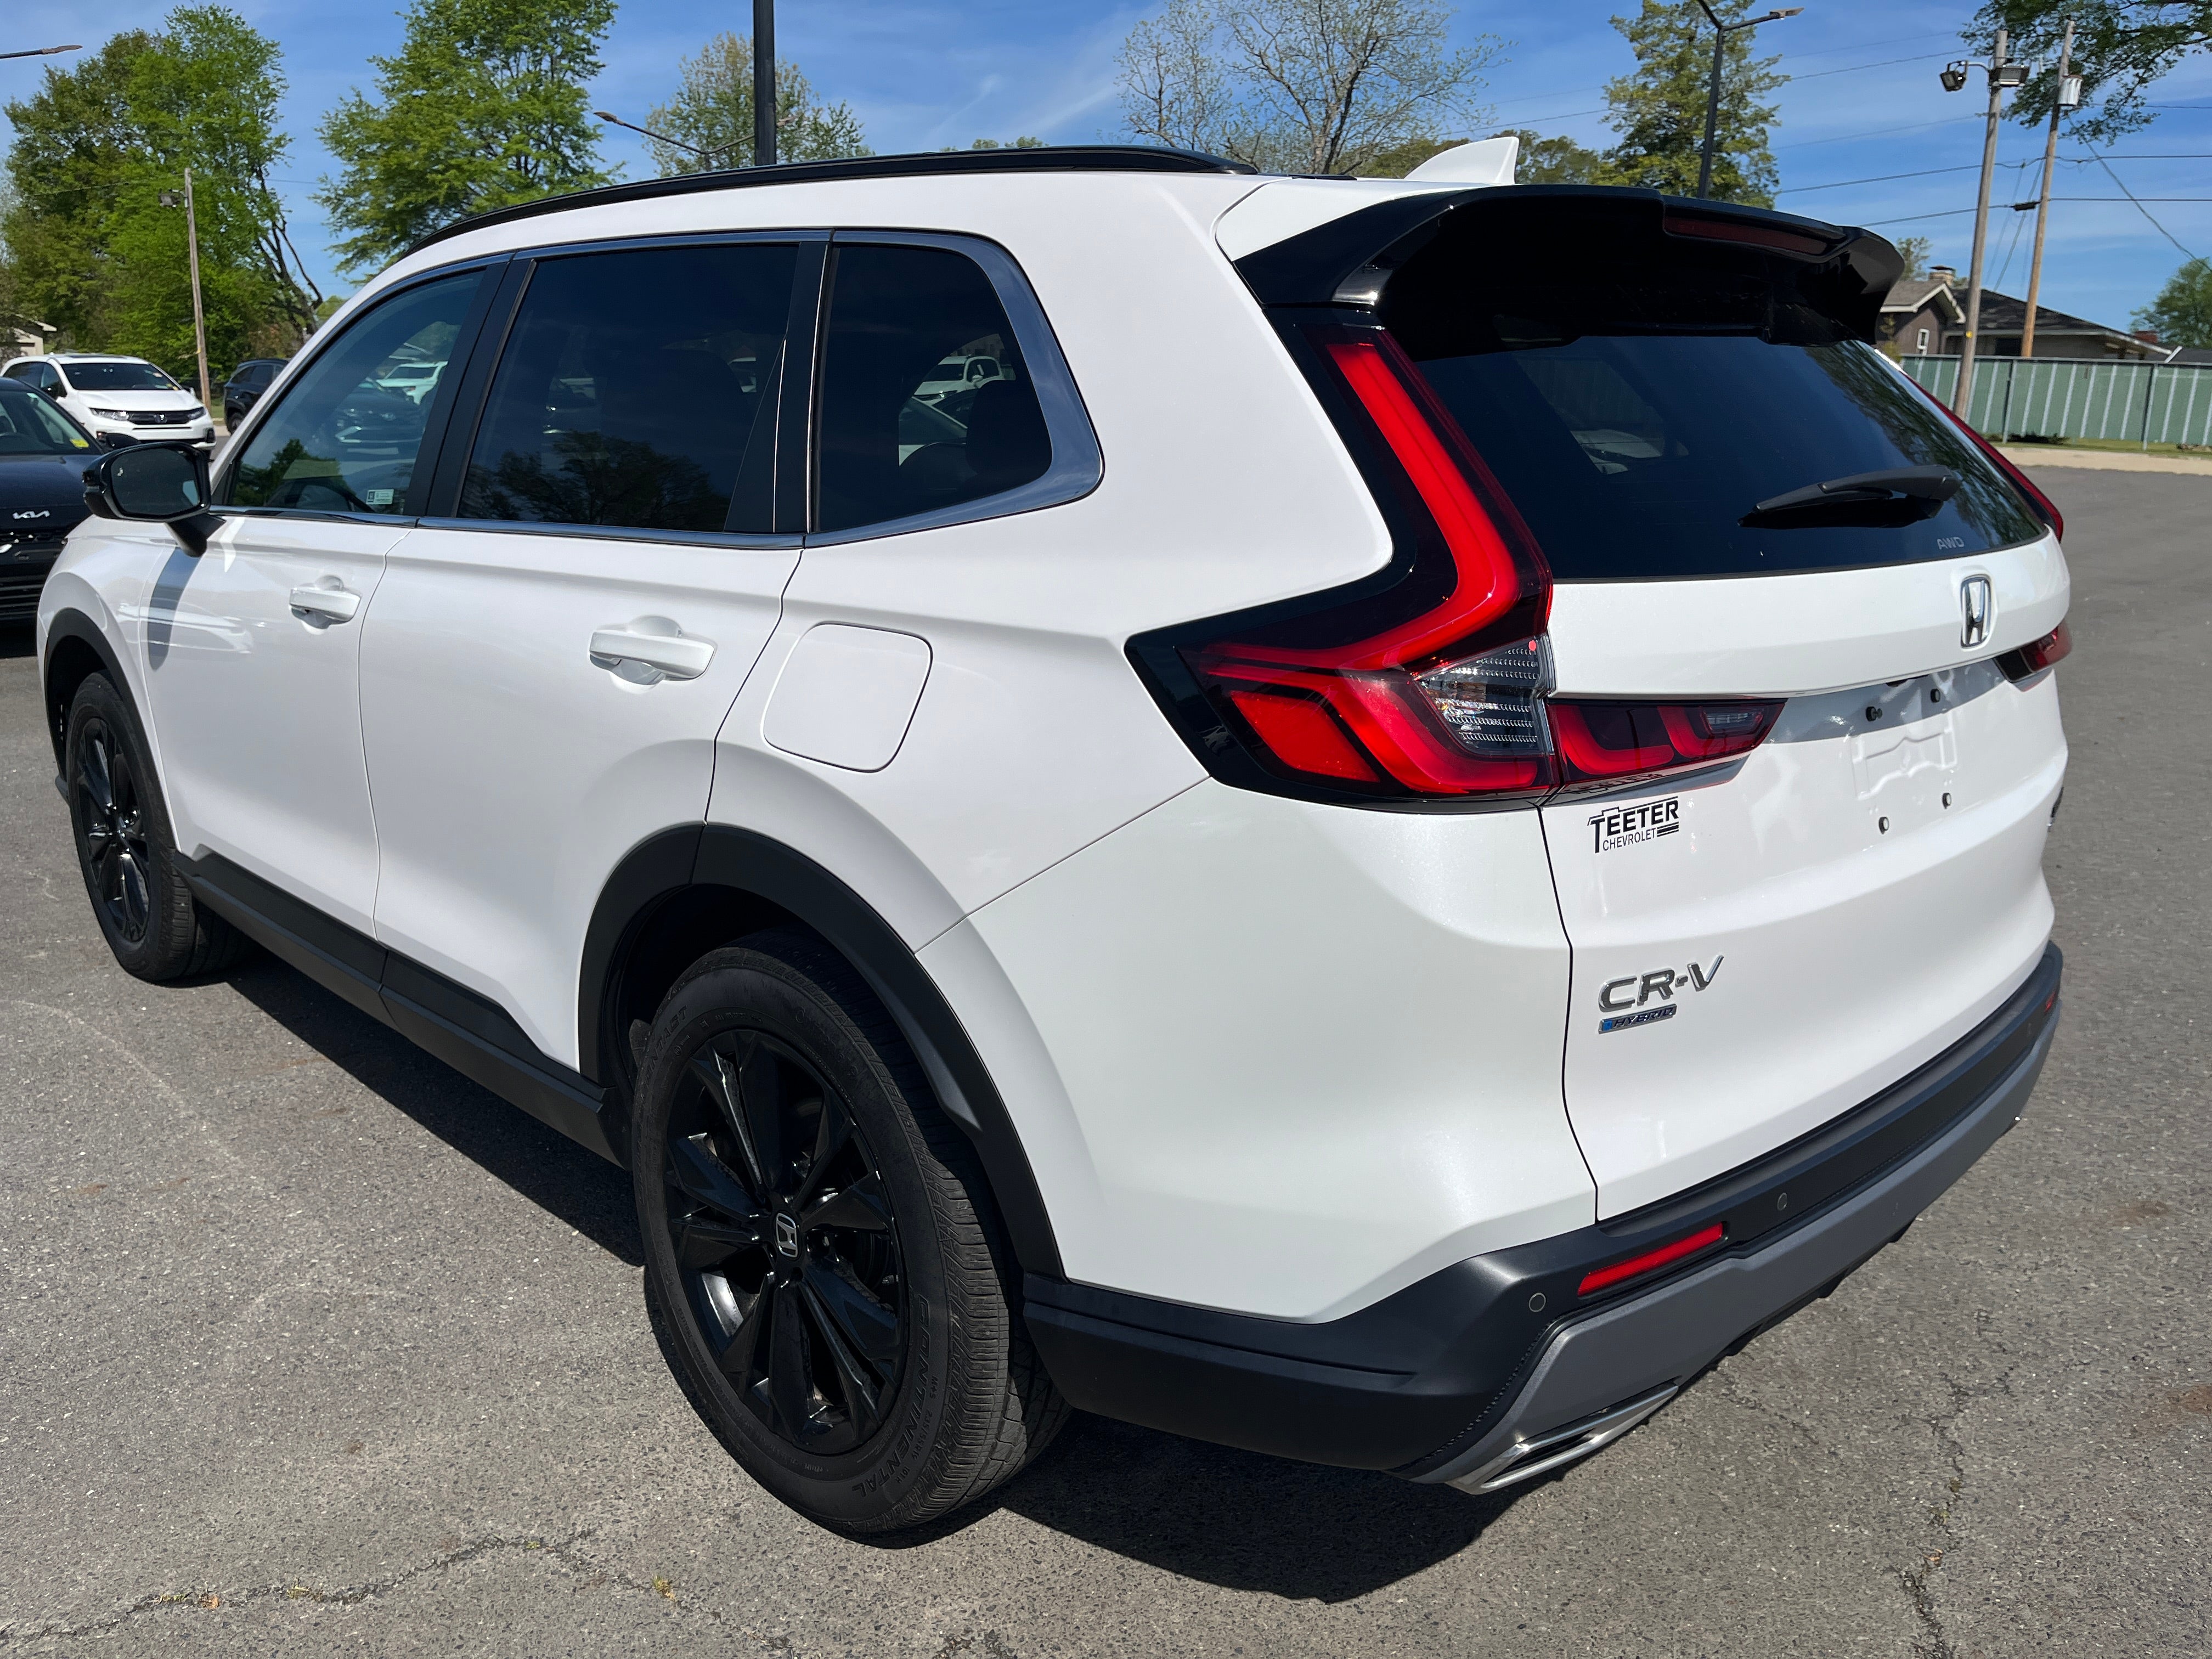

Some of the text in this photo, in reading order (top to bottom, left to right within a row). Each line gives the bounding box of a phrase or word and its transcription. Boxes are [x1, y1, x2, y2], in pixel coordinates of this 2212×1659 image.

[1937, 536, 1965, 550] AWD
[1590, 799, 1679, 854] TEETER
[1602, 827, 1657, 851] CHEVROLET
[1598, 954, 1724, 1012] CR-V
[1612, 1006, 1674, 1028] HYBRID
[851, 1293, 930, 1498] CONTINENTAL
